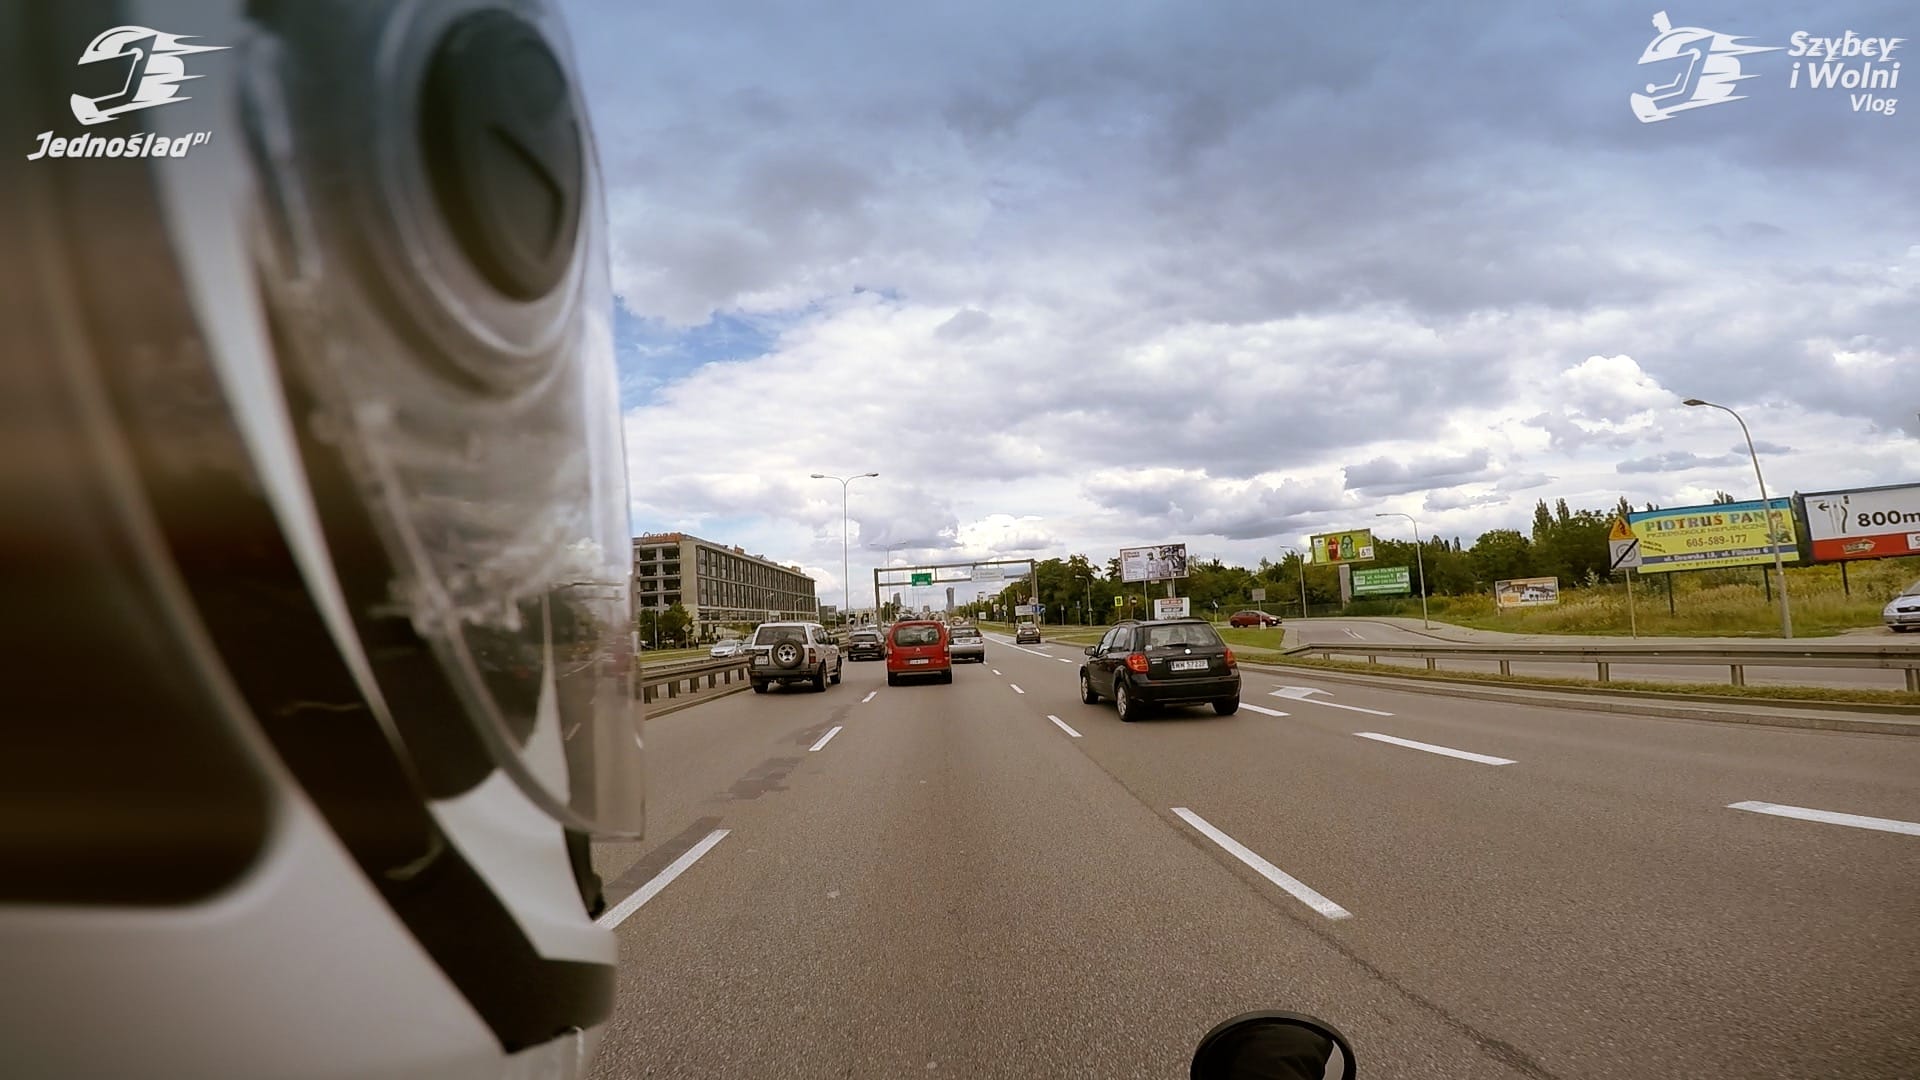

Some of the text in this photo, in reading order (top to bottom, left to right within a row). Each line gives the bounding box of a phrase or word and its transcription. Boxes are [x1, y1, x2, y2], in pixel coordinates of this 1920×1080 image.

[1645, 512, 1764, 531] PIOTRUŚ PAN
[1686, 534, 1748, 547] 605-589-177
